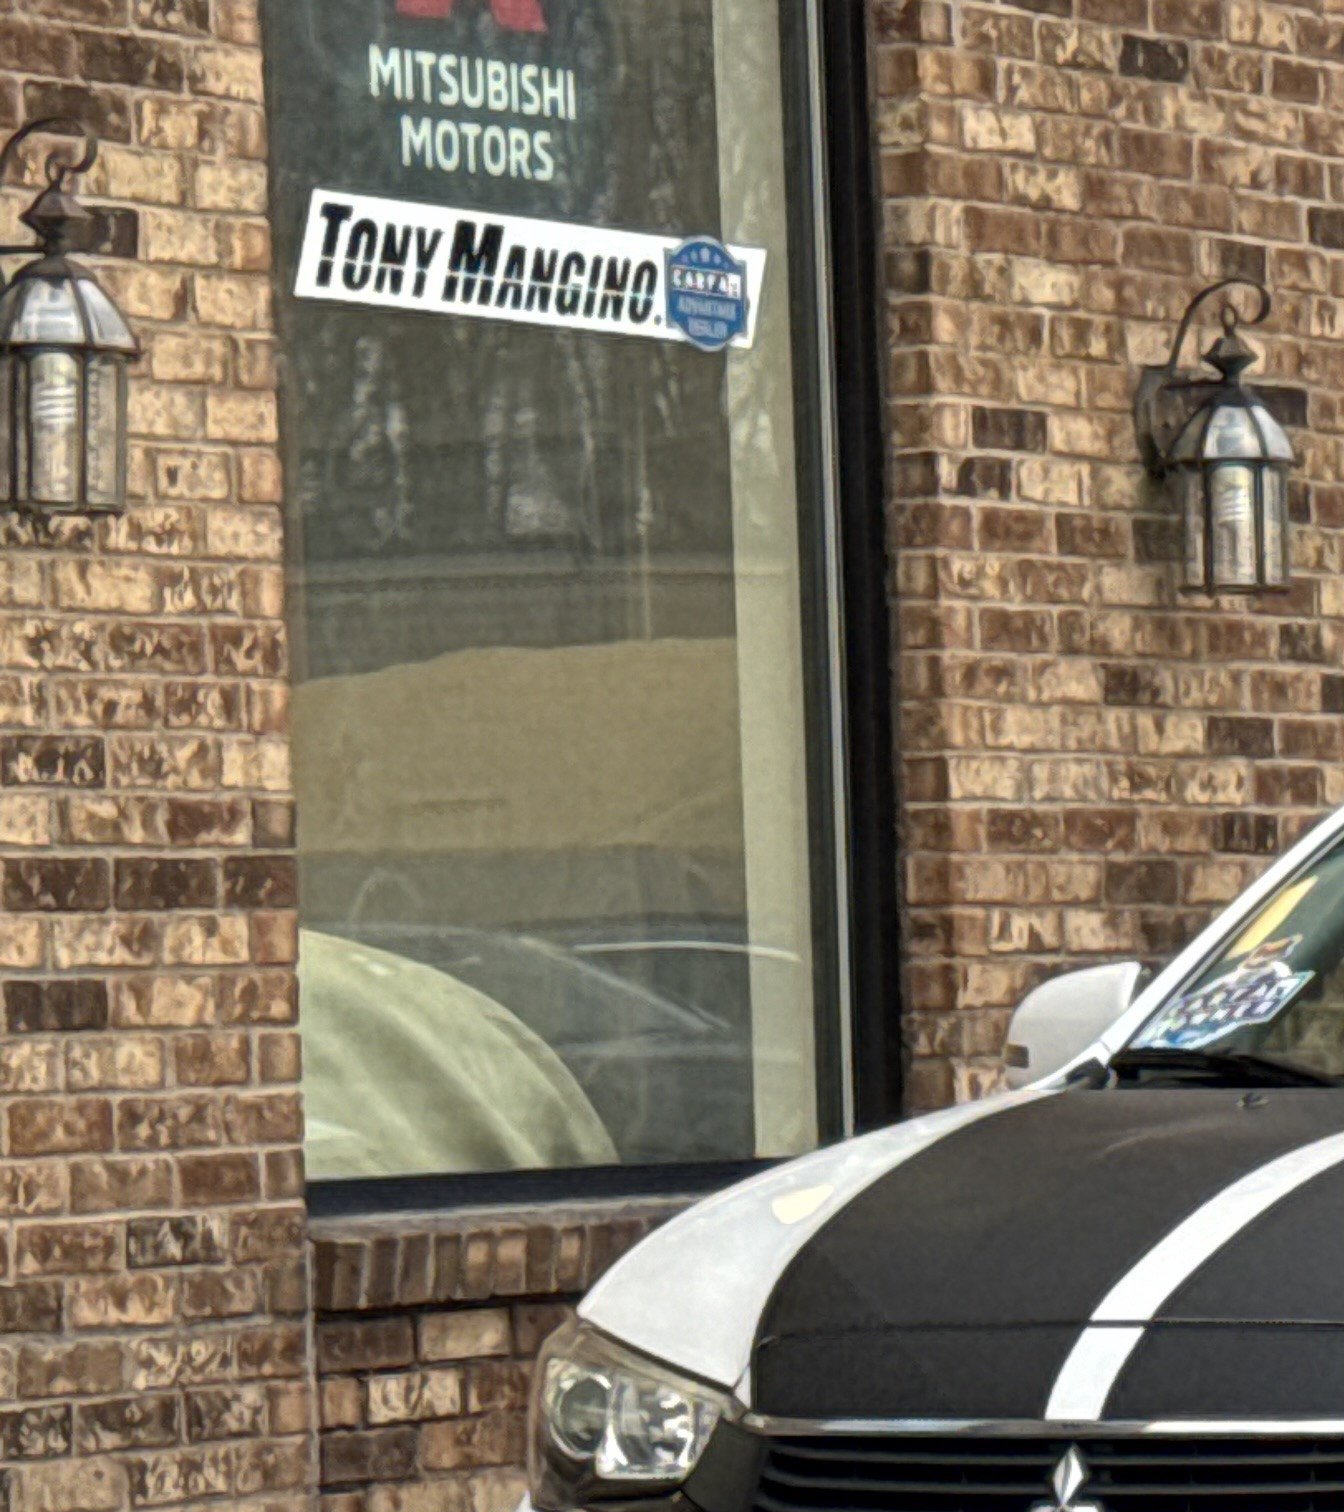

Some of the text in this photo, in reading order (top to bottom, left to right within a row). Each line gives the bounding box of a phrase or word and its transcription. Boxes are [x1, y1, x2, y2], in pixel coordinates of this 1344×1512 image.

[368, 44, 577, 120] MITSUBISHI
[400, 116, 556, 182] MOTORS
[315, 202, 443, 298] TONY
